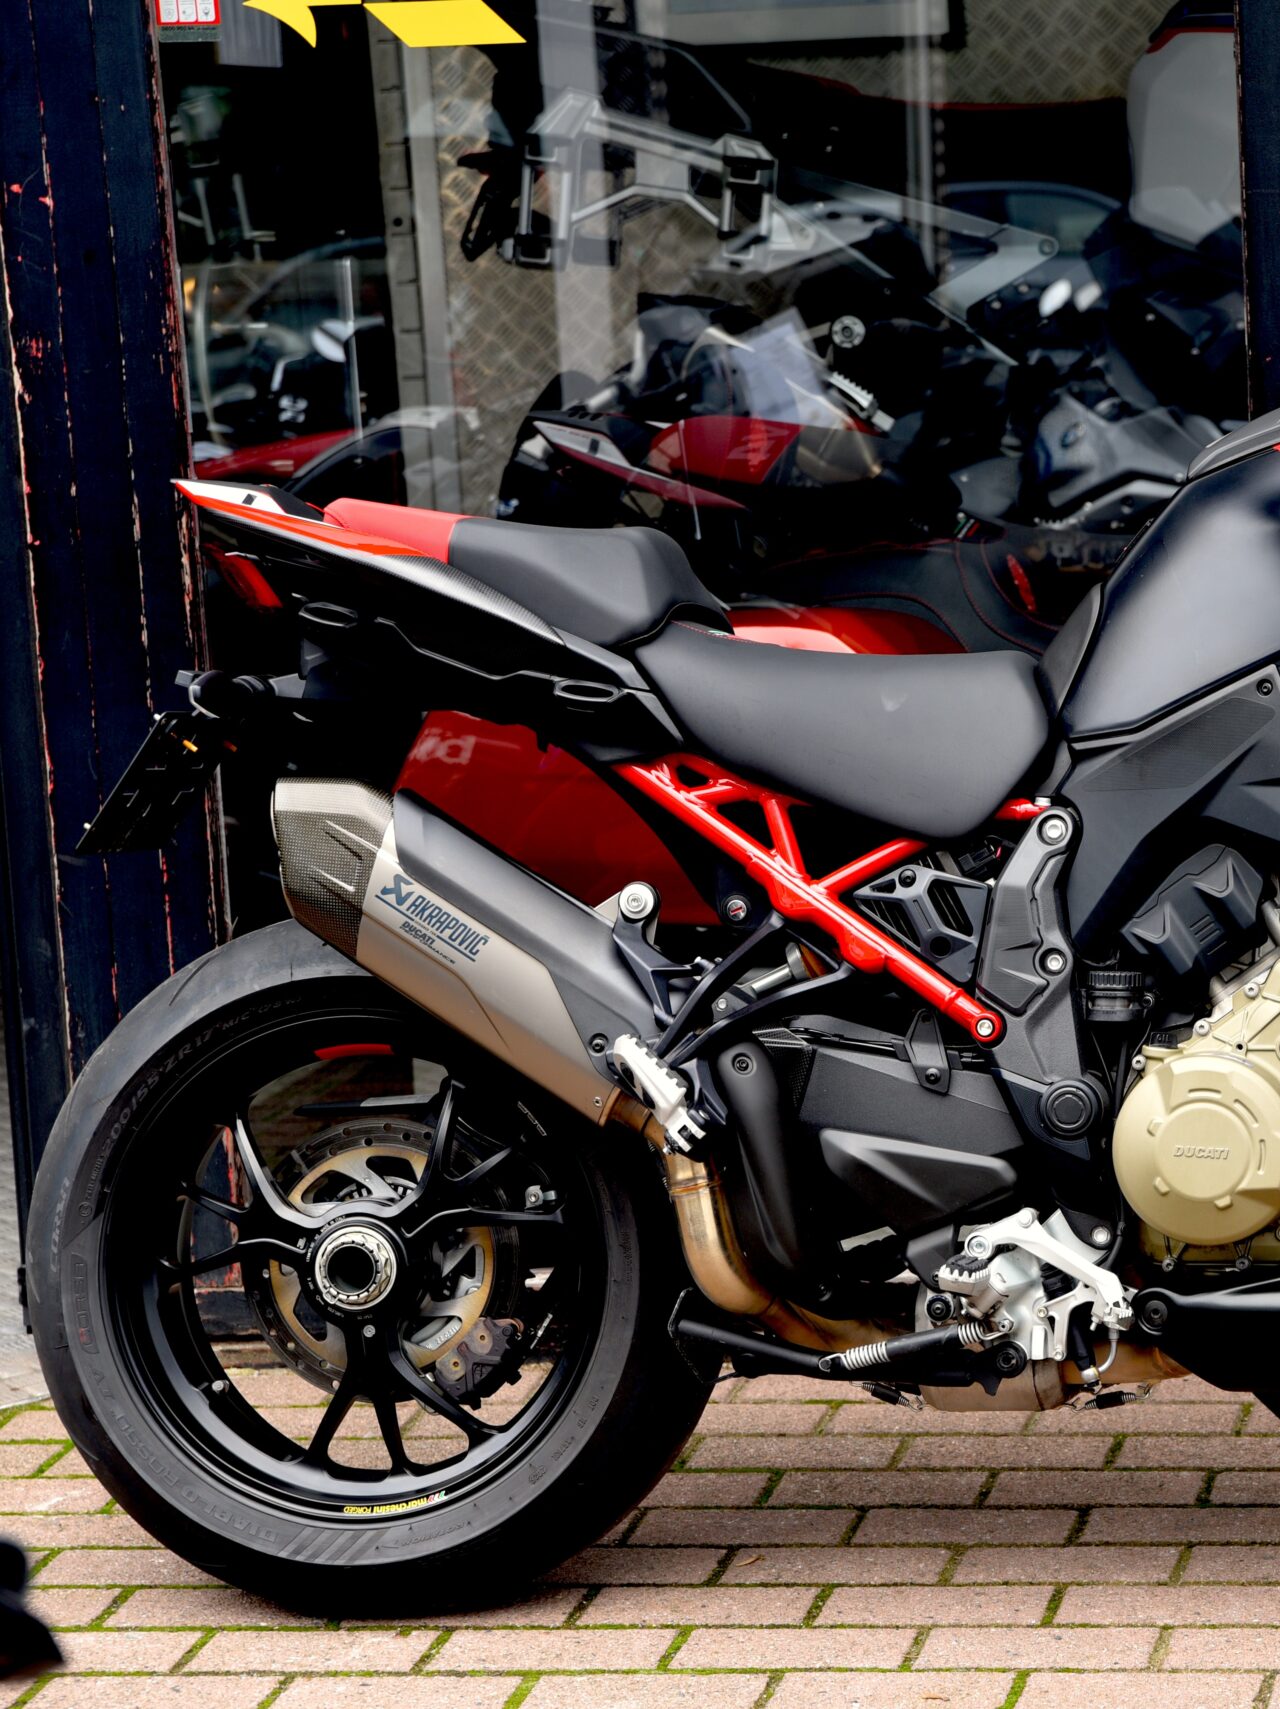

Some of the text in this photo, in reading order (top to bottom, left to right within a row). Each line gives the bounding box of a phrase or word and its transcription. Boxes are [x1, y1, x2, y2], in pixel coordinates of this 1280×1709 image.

[401, 921, 436, 946] DUCATI
[1173, 1145, 1230, 1160] DUCATI
[343, 1498, 428, 1515] marchesini FORGED
